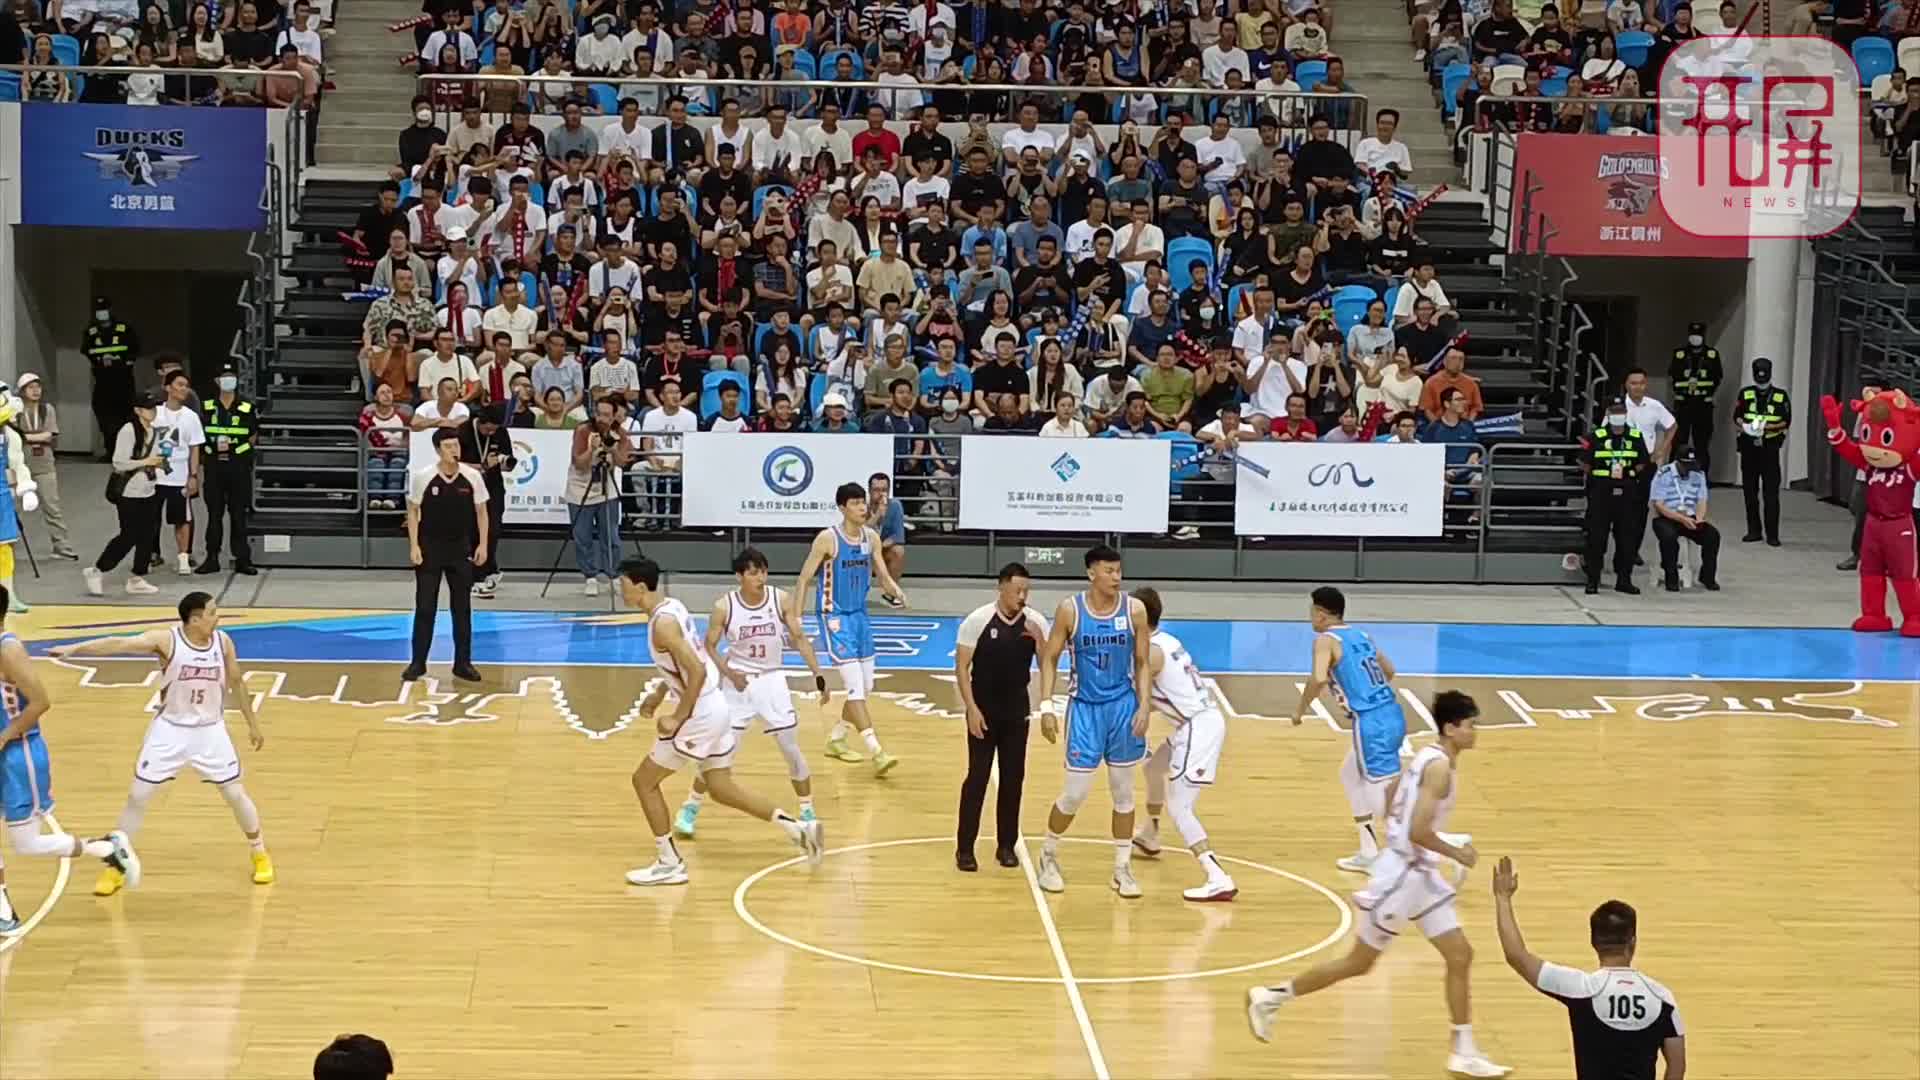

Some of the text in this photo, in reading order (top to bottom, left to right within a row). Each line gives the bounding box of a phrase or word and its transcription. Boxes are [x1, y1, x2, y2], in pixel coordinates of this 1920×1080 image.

[96, 128, 185, 149] DUCKS
[1598, 155, 1669, 179] GOLDENBULS
[1082, 633, 1126, 647] BEIJING
[749, 643, 767, 659] 33
[190, 688, 206, 705] 15
[1608, 994, 1647, 1020] 105
